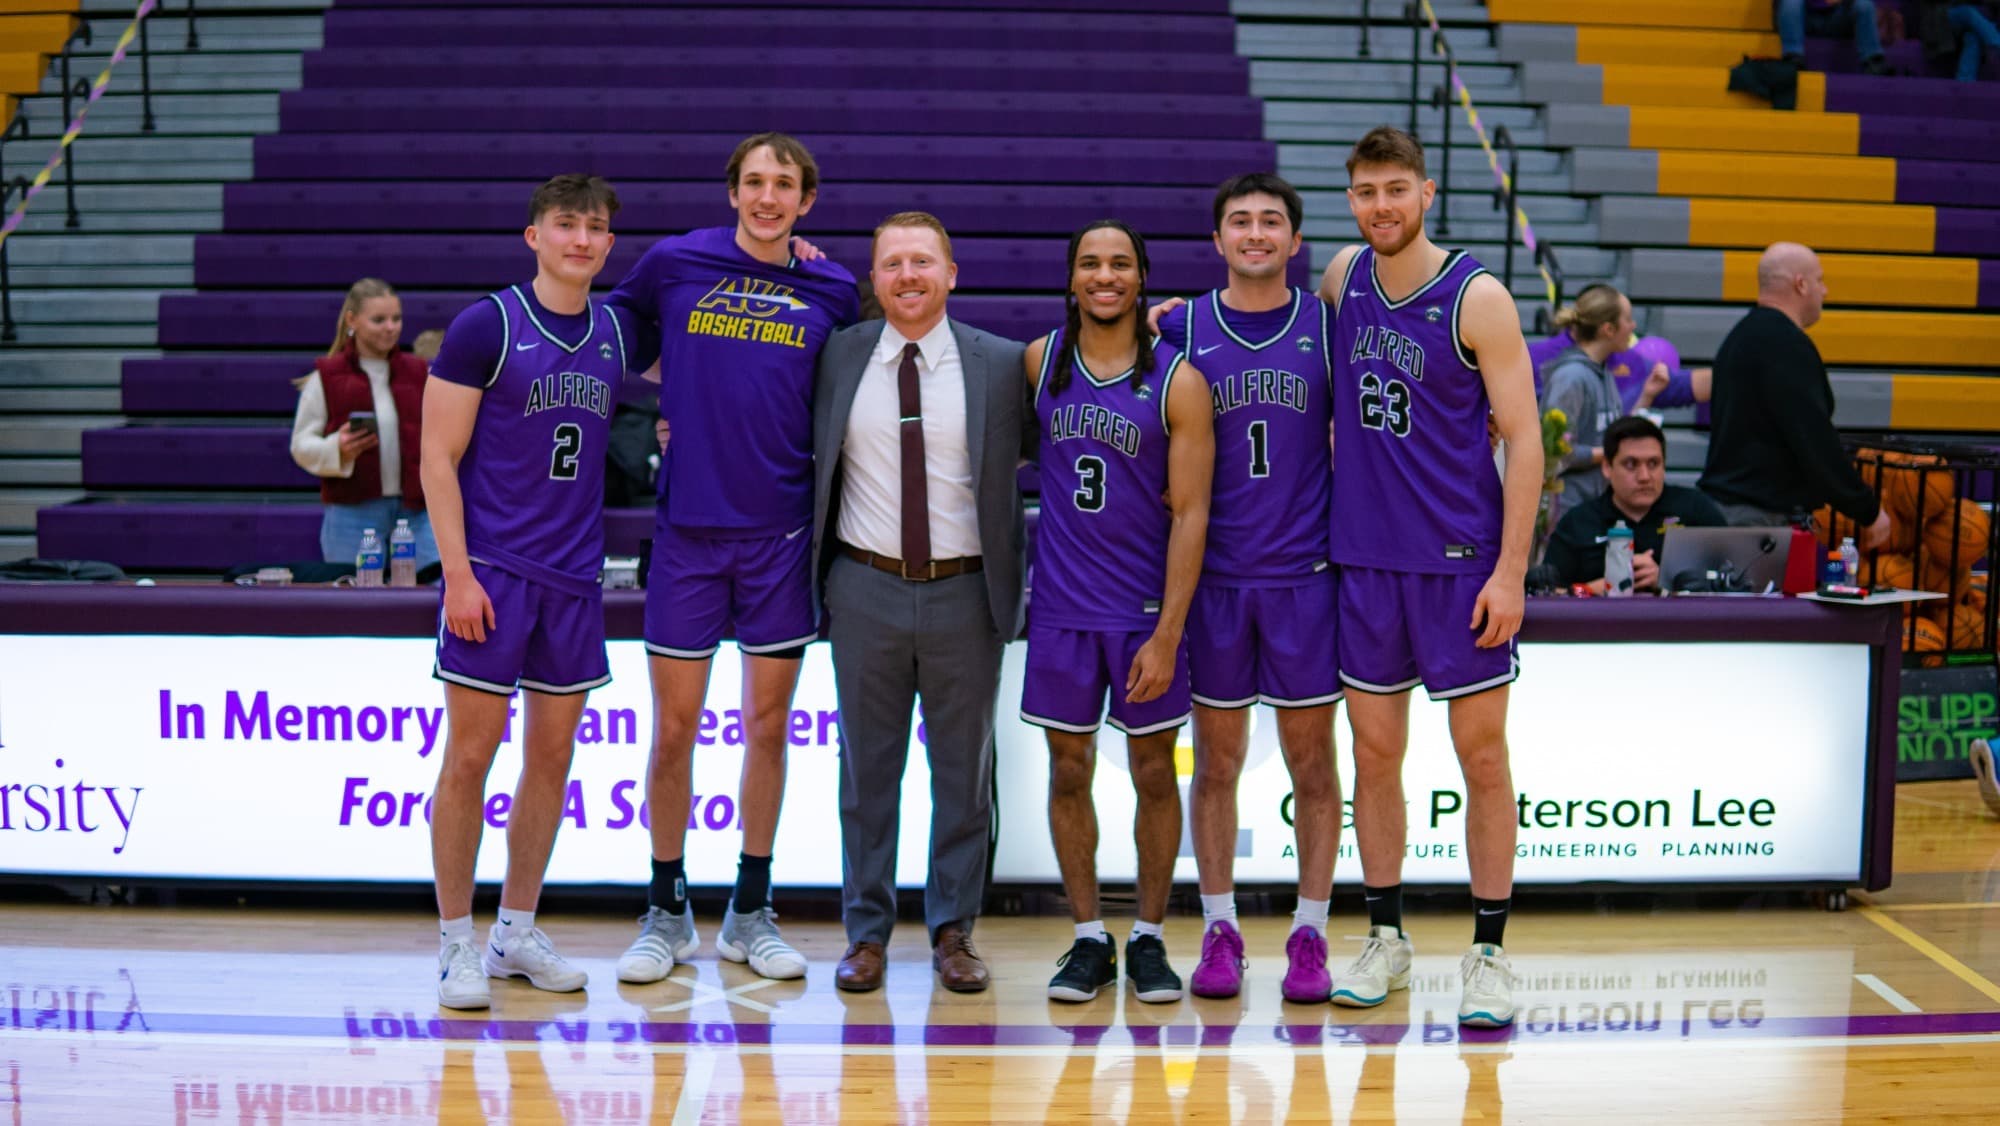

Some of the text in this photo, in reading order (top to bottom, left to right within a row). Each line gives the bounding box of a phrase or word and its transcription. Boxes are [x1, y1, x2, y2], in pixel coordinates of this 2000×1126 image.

[687, 310, 806, 348] BASKETBALL
[1350, 326, 1425, 382] ALFRED
[524, 372, 611, 420] ALFRED
[1211, 368, 1308, 418] ALFRED
[1360, 371, 1411, 438] 23
[549, 422, 582, 481] 2
[1051, 403, 1141, 458] ALFRED
[1247, 420, 1270, 478] 1
[1073, 454, 1106, 513] 3
[159, 689, 205, 739] In
[224, 690, 445, 758] Memory
[1898, 693, 1996, 733] SLIPP
[561, 780, 587, 829] A
[1692, 789, 1776, 828] Lee
[1662, 841, 1775, 857] PLANNING
